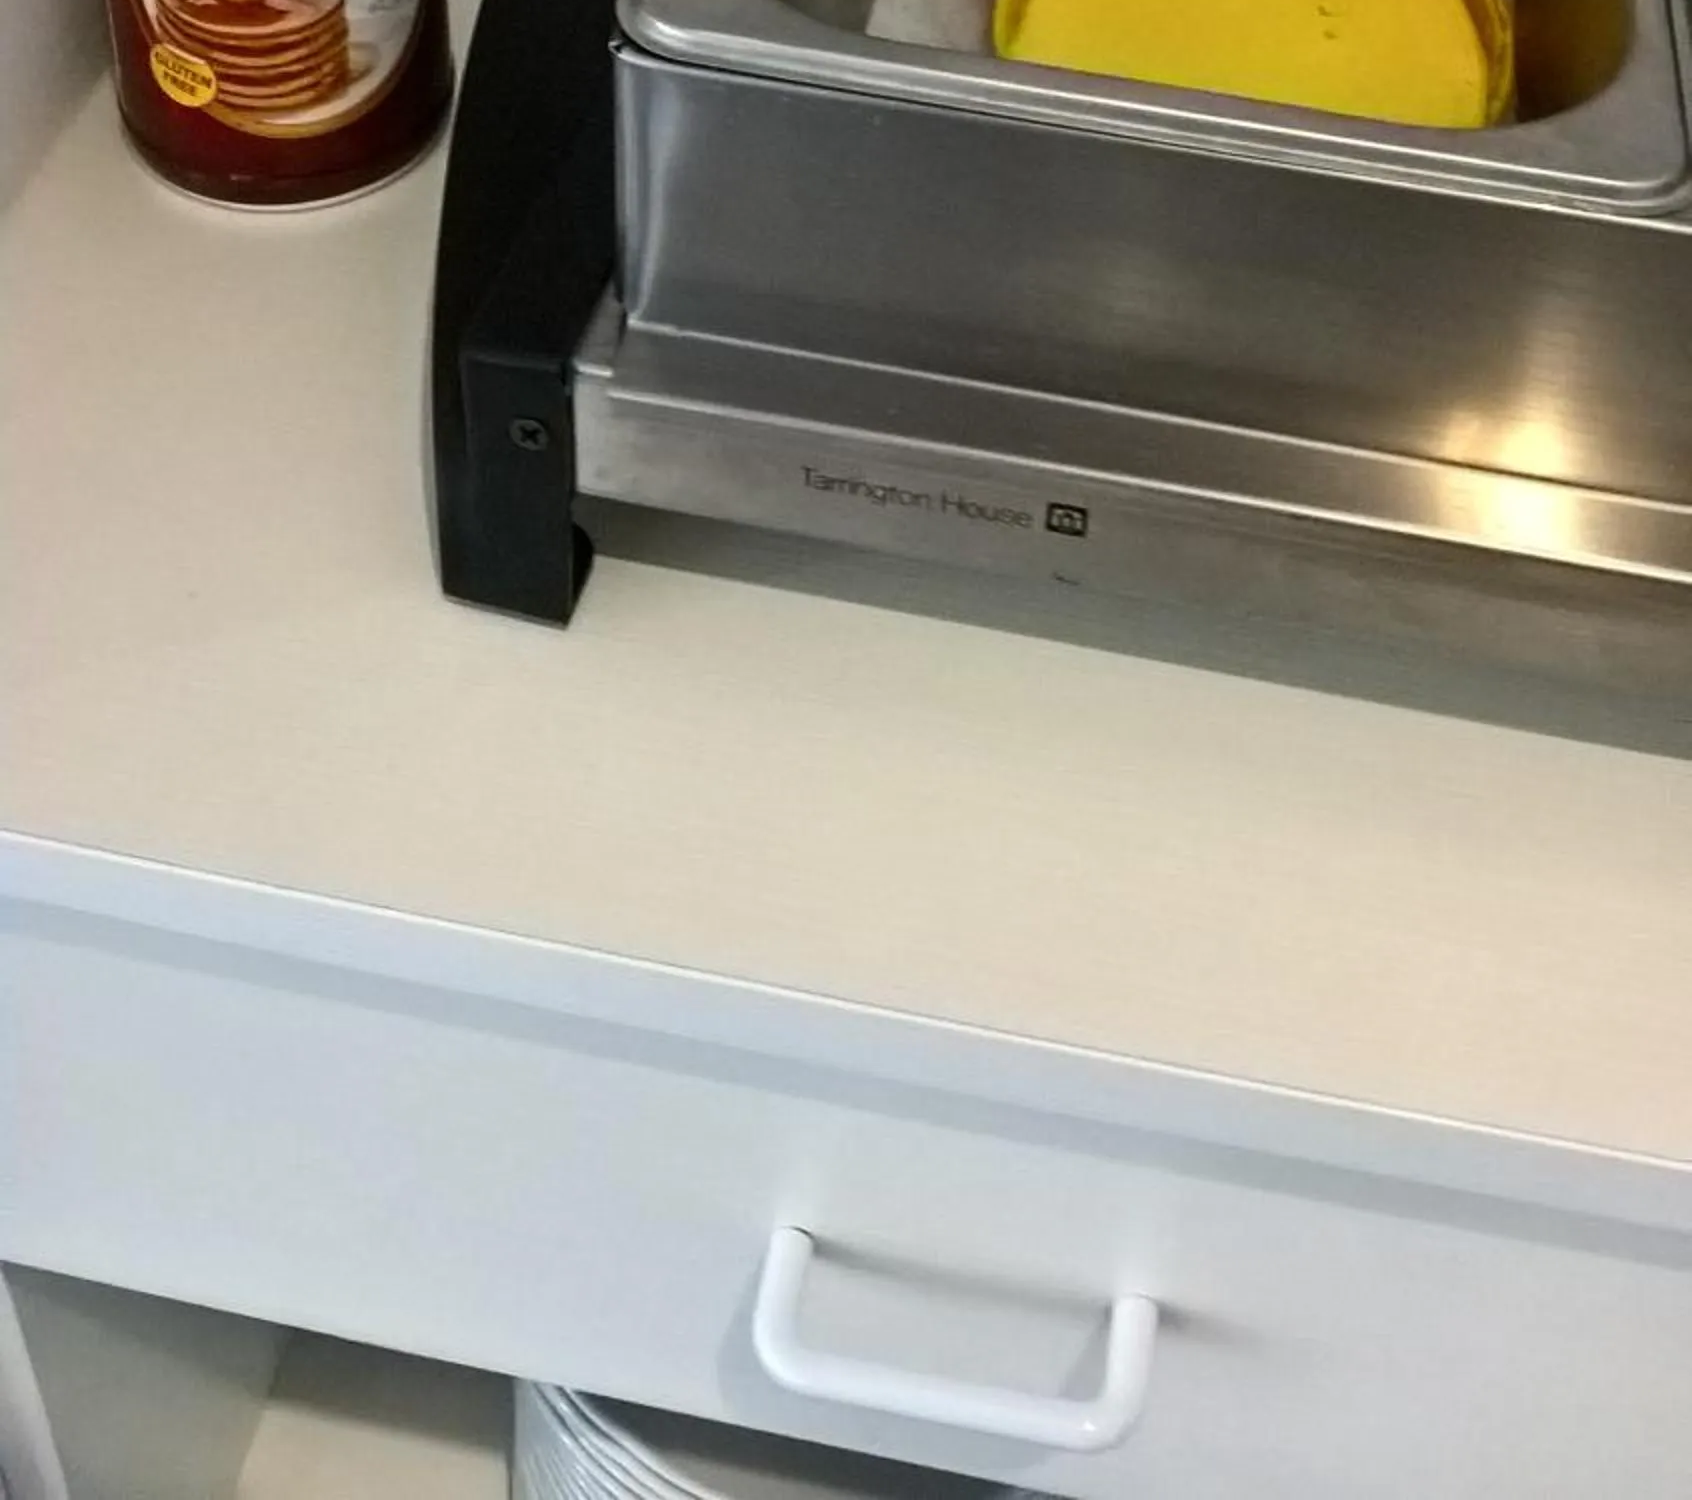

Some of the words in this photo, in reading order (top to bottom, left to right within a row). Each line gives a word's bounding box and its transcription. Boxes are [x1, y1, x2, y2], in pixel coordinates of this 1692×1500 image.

[155, 51, 213, 90] GLUTEN
[163, 69, 197, 97] FREE
[802, 465, 931, 509] Tarrington
[940, 489, 1034, 529] House
